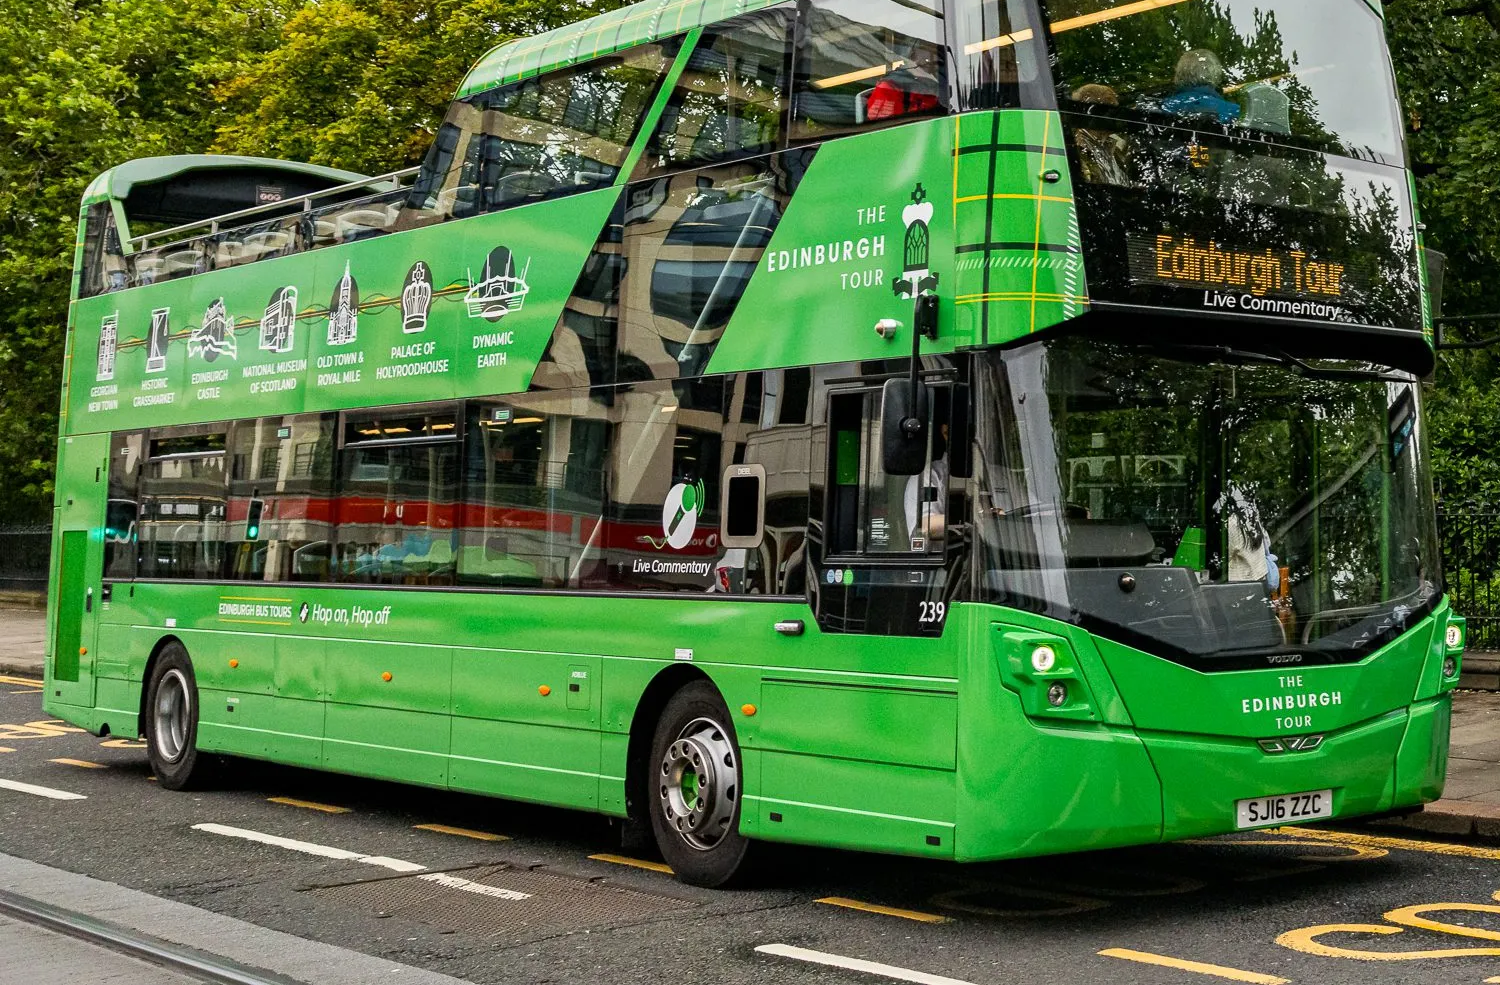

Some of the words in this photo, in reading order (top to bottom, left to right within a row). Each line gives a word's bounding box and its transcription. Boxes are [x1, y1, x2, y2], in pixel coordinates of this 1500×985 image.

[856, 205, 887, 226] THE
[1388, 231, 1413, 252] 239
[767, 235, 885, 273] EDINBURGH
[1155, 234, 1282, 297] Edinburgh
[1290, 250, 1344, 296] Tour
[840, 268, 884, 291] TOUR
[1203, 290, 1236, 308] Live
[1240, 293, 1342, 321] Commentary
[472, 331, 514, 349] DYNAMIC
[391, 343, 422, 360] PALACE
[423, 341, 436, 354] OF
[242, 364, 276, 378] NATIONAL
[276, 358, 308, 374] MUSEUM
[317, 356, 332, 369] OLD
[334, 352, 357, 366] TOWN
[358, 351, 365, 364] &
[477, 352, 507, 368] EARTH
[191, 369, 229, 385] EDINBURGH
[317, 373, 342, 386] ROYAL
[342, 369, 361, 384] MILE
[375, 359, 449, 380] HOLYROODHOUSE
[141, 377, 169, 391] HISTORIC
[250, 382, 260, 394] OF
[260, 378, 297, 393] SCOTLAND
[133, 392, 176, 407] GRASSMARKET
[197, 387, 221, 400] CASTLE
[632, 559, 651, 573] Live
[651, 559, 711, 577] Commentary
[218, 602, 255, 617] EDINBURGH
[255, 604, 268, 617] BUS
[269, 605, 292, 618] TOURS
[312, 604, 332, 625] Hop
[333, 609, 349, 626] on,
[351, 605, 373, 628] Hop
[375, 605, 391, 625] off
[919, 600, 945, 623] 239
[1266, 654, 1303, 664] VOLVO
[1278, 675, 1303, 688] THE
[1242, 691, 1342, 713] EDINBURGH
[1275, 715, 1312, 729] TOUR
[1248, 798, 1286, 822] SJ16
[1290, 794, 1322, 817] ZZC
